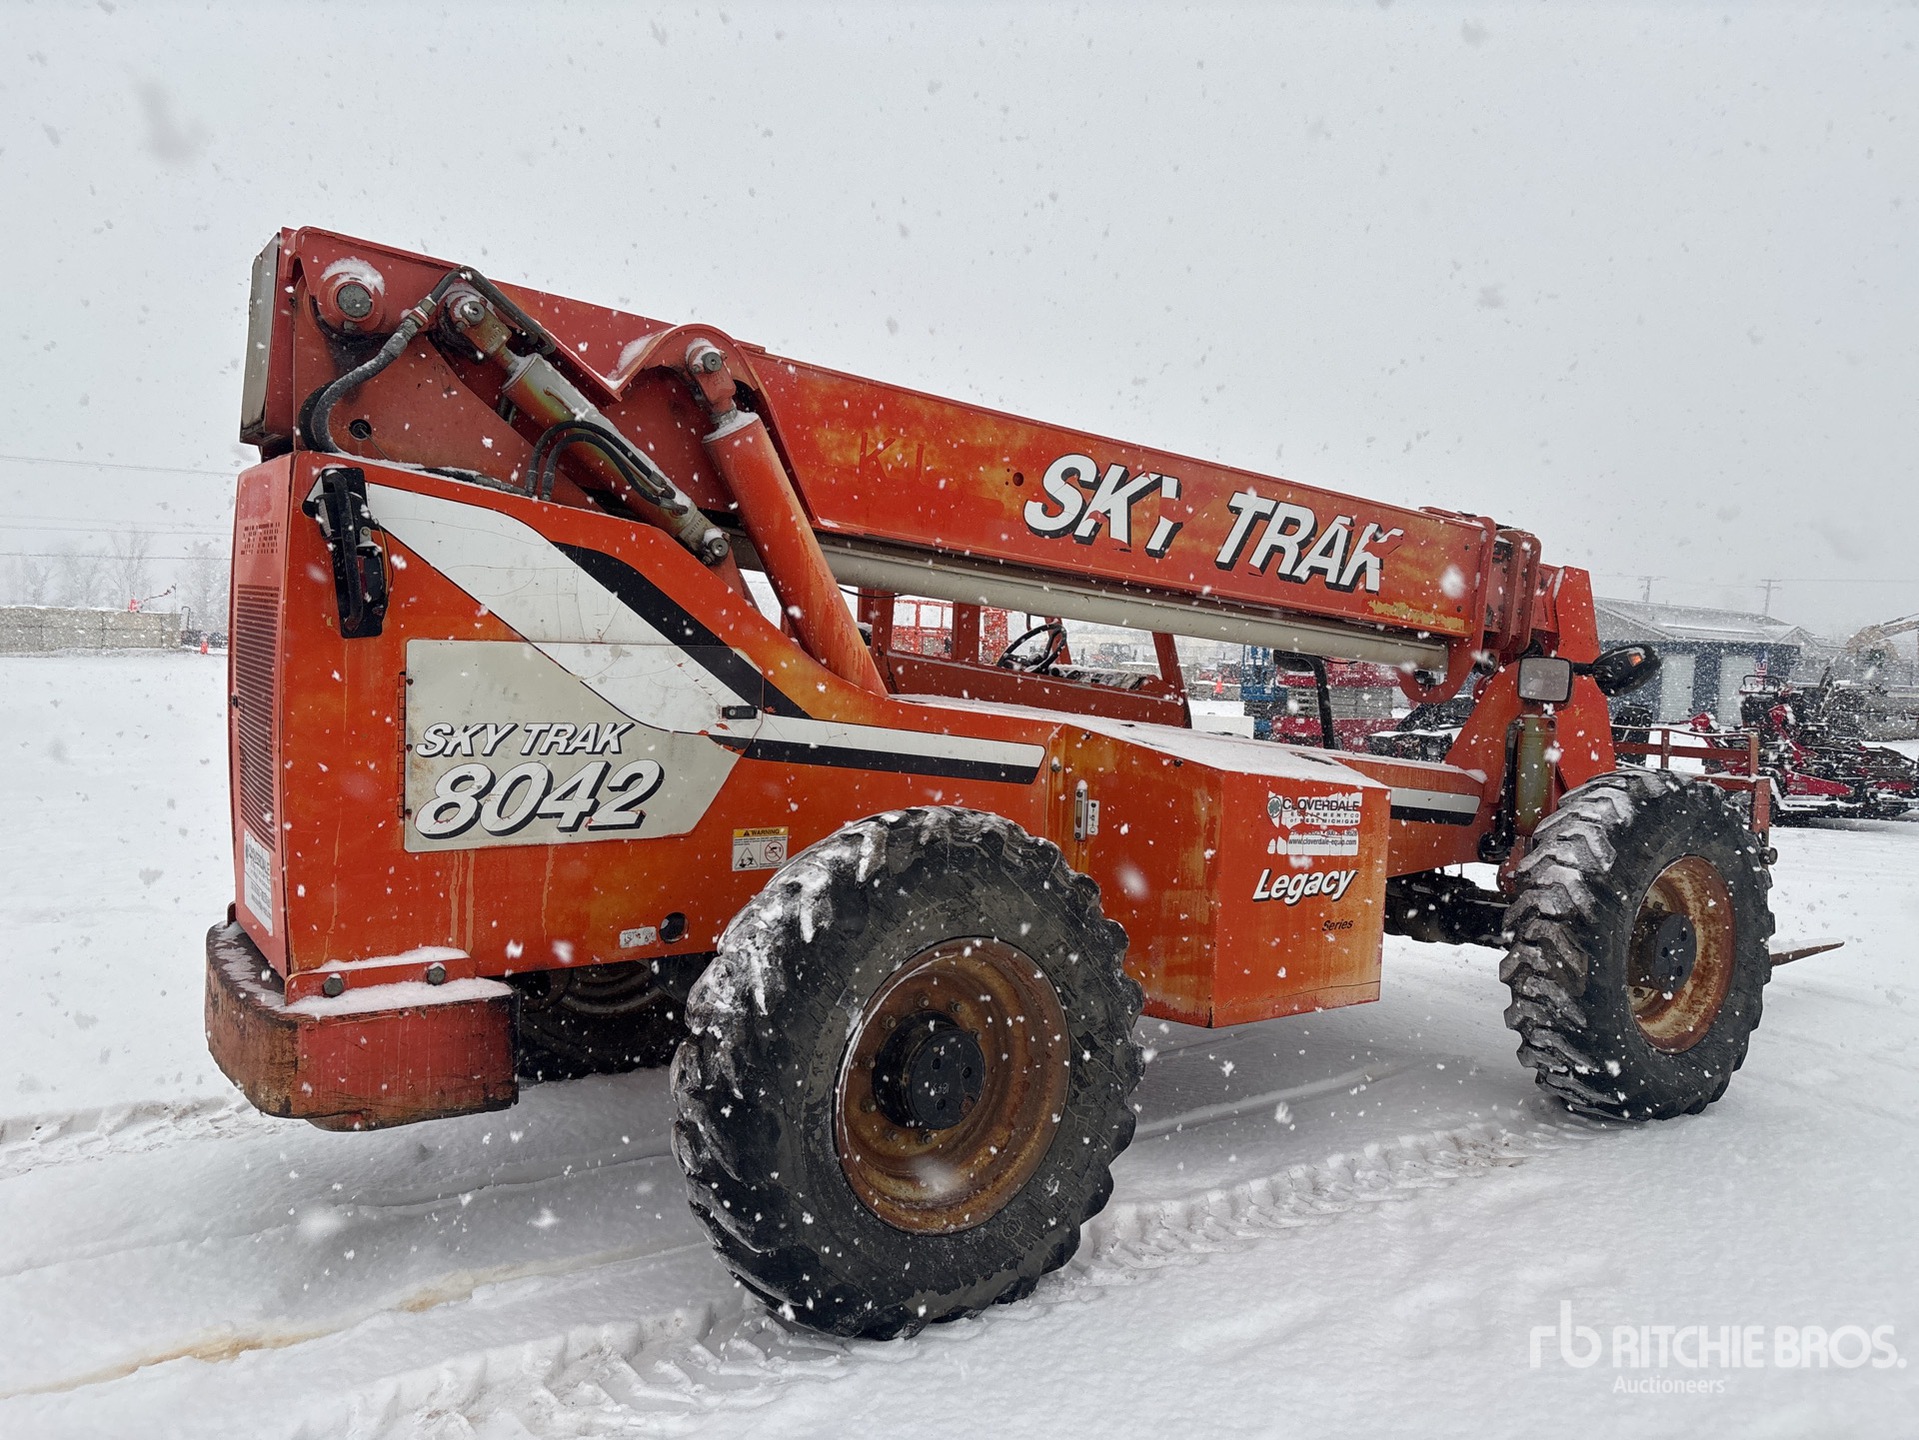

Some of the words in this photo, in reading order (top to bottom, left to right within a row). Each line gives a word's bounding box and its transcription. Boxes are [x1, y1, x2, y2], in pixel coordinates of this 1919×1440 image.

[1215, 490, 1403, 595] TRAK
[416, 722, 518, 757] SKY
[520, 722, 635, 756] TRAK
[415, 759, 665, 840] 8042
[751, 828, 780, 836] WARNING
[1252, 868, 1359, 906] Legacy
[1321, 919, 1354, 932] Series
